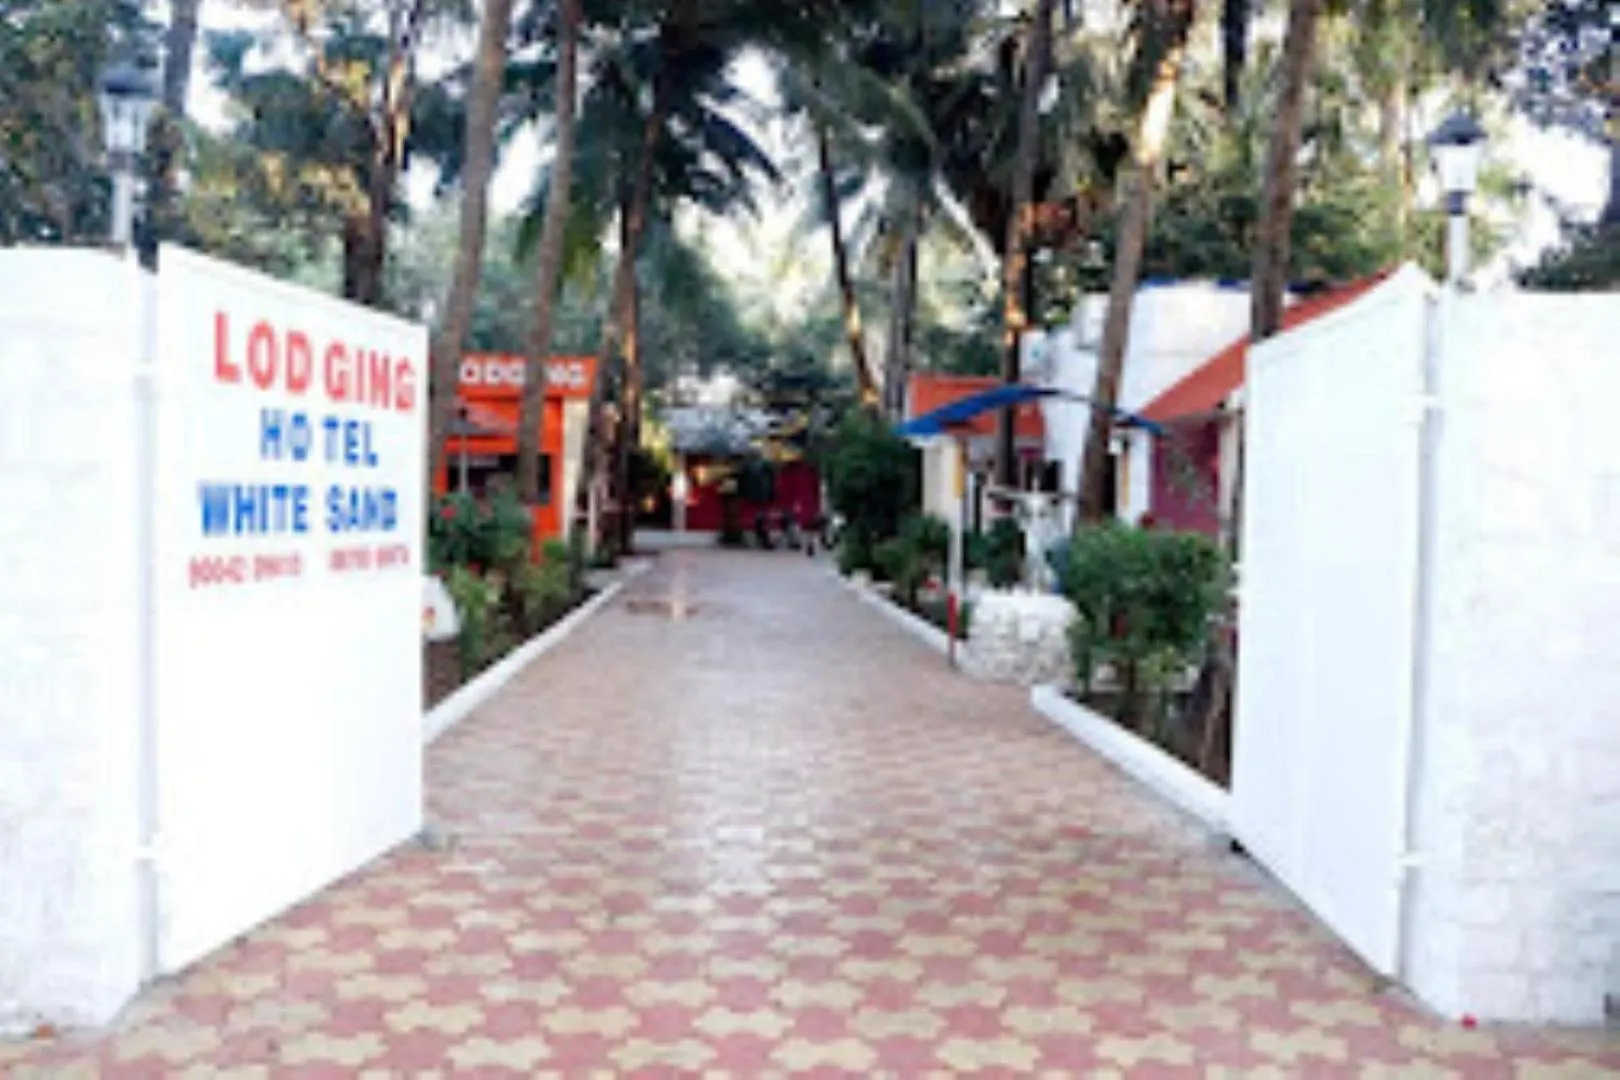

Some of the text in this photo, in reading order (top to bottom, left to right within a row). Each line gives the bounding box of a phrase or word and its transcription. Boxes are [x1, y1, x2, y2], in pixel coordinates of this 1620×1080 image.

[213, 311, 416, 412] LODGING
[260, 408, 378, 466] HOTEL
[199, 482, 398, 536] WHITE SAND
